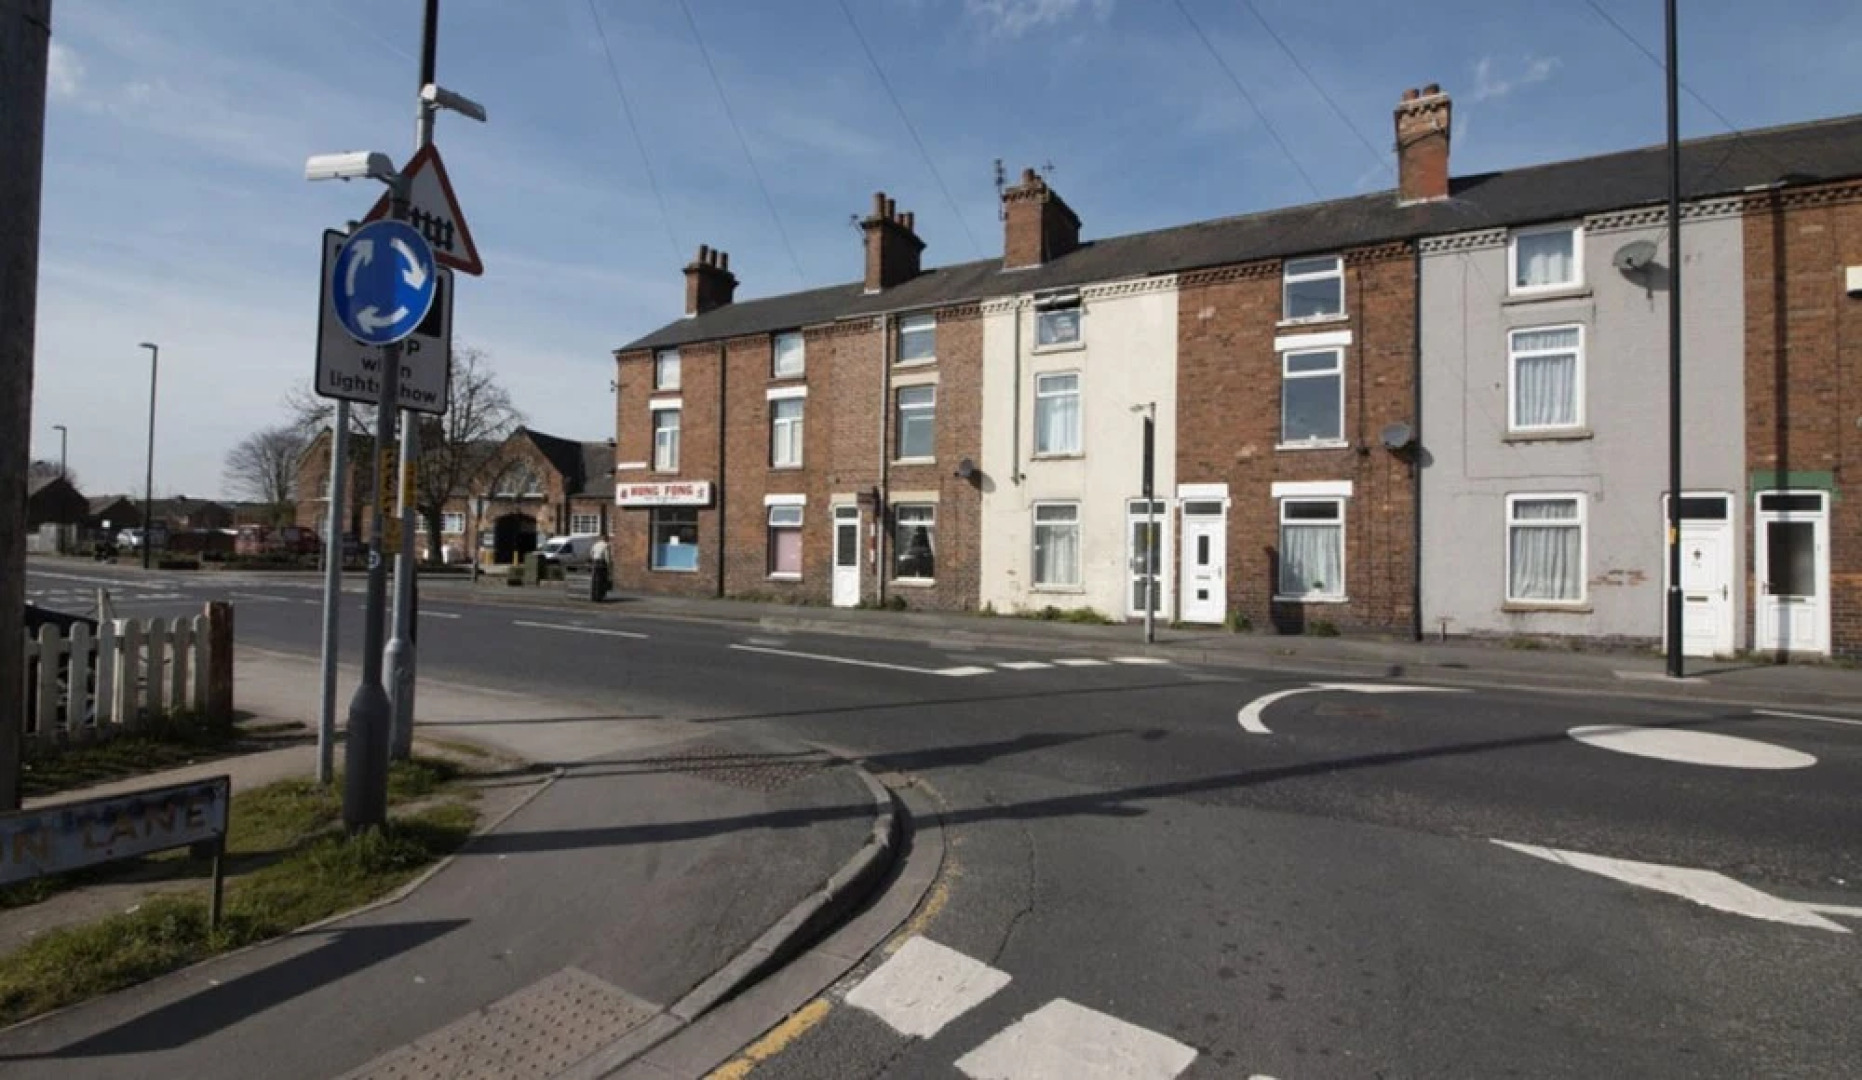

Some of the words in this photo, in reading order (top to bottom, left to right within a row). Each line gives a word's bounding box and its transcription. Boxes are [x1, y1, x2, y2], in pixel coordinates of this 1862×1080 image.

[400, 383, 437, 403] how
[0, 825, 52, 866] N
[82, 798, 207, 849] LANE
